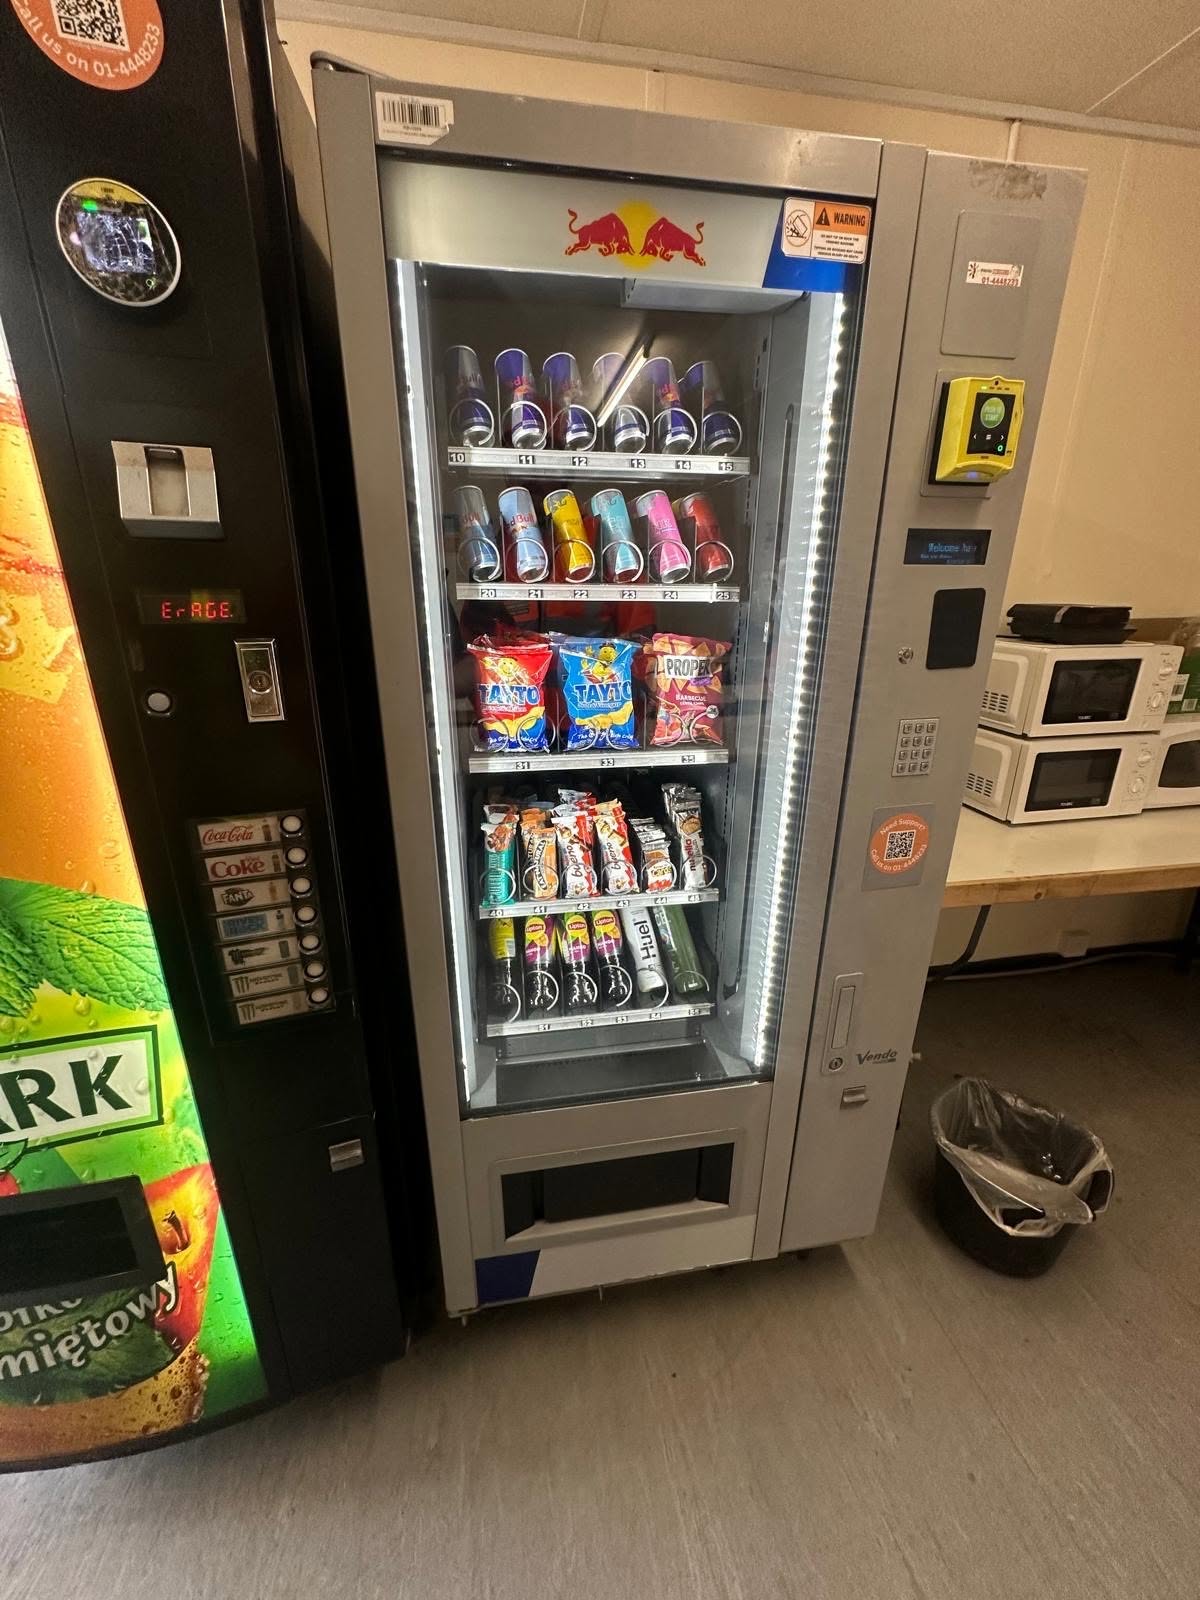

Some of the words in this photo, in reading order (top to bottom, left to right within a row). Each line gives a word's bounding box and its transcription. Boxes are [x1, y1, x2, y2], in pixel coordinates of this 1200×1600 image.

[42, 33, 62, 55] us
[66, 52, 89, 72] on
[93, 23, 160, 78] 01-4448233
[834, 212, 866, 227] WARNING
[450, 453, 465, 463] 10
[520, 455, 533, 465] 11
[573, 457, 587, 467] 12
[632, 459, 645, 468] 13
[677, 461, 691, 470] 14
[720, 462, 733, 471] 15
[481, 590, 496, 598] 20
[529, 590, 542, 598] 21
[623, 591, 636, 599] 23
[664, 591, 677, 600] 24
[516, 761, 529, 769] 31
[880, 820, 898, 835] Need
[203, 826, 254, 846] Coca-Cola
[567, 845, 583, 877] bueno
[607, 842, 621, 870] bueno
[210, 860, 265, 878] Coke
[223, 890, 253, 903] FANTA
[634, 920, 656, 960] Huel
[856, 1048, 898, 1064] Vendo
